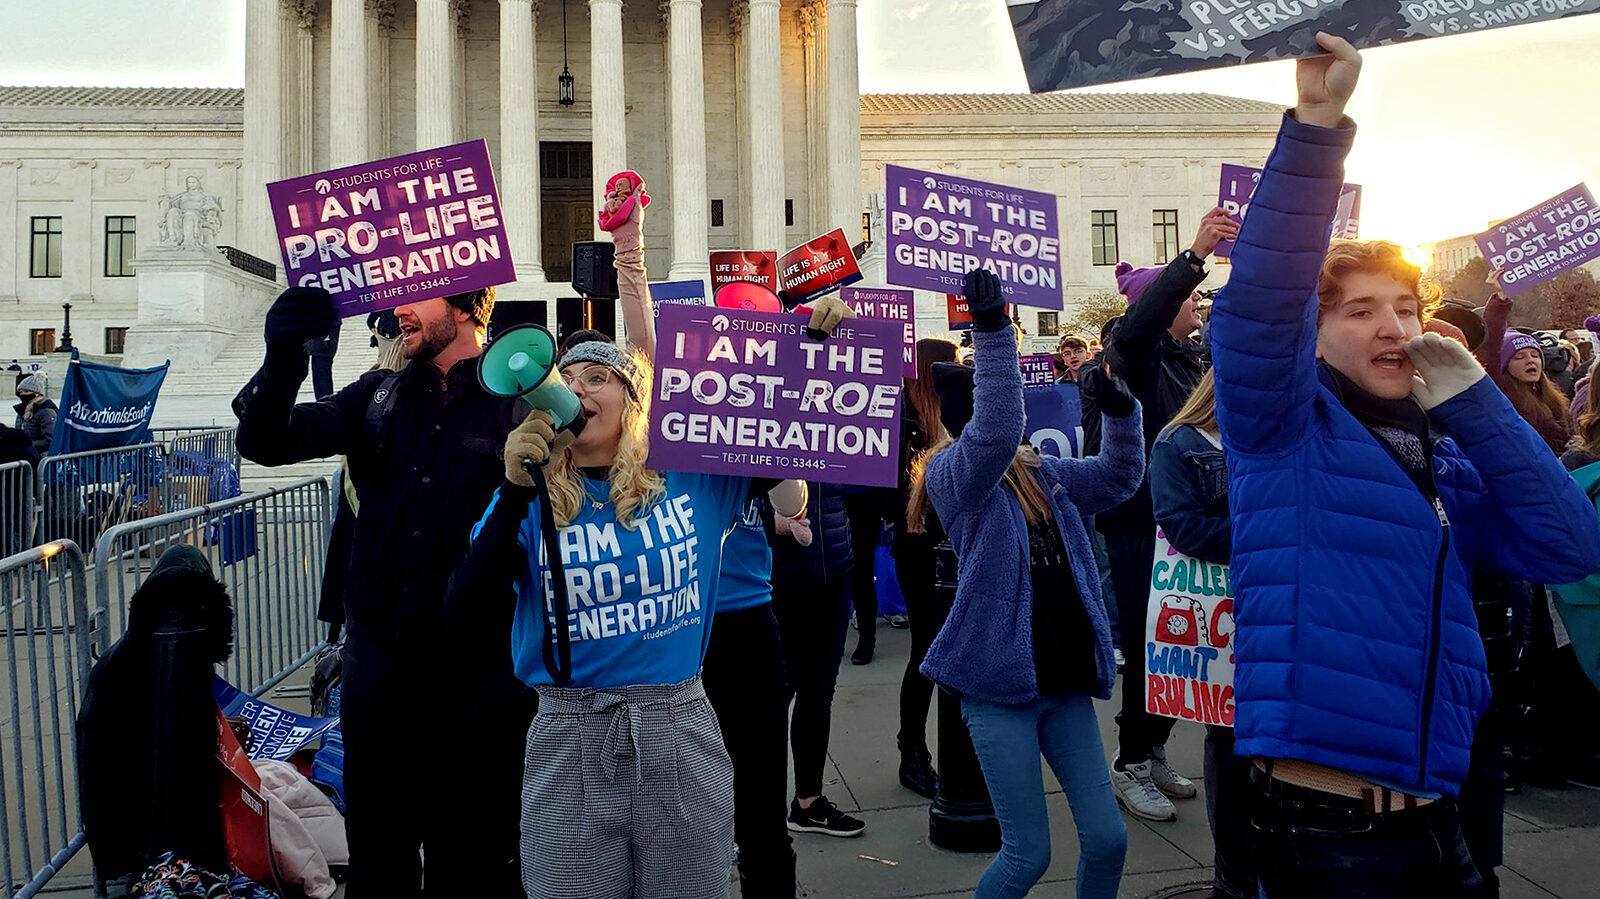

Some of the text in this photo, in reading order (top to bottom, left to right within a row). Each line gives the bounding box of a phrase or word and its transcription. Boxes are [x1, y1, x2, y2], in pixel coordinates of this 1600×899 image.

[1184, 0, 1334, 52] VS. FERG
[1430, 18, 1468, 34] VS.
[333, 157, 443, 189] STUDENTS FOR LIFE
[288, 167, 478, 229] I AM THE
[899, 186, 1047, 231] I AM THE
[937, 181, 1024, 204] STUDENTS FOR LIFE
[284, 194, 499, 270] PRO-LIFE
[891, 211, 1059, 262] POST-ROE
[1487, 196, 1588, 253] I AM THE
[1507, 211, 1539, 229] STUDENTS
[1490, 207, 1600, 270] POST-ROE
[715, 264, 749, 272] LIFE IS A
[783, 256, 820, 278] LIFE IS A
[785, 256, 846, 289] HUMAN RIGHT
[940, 275, 958, 287] TEXT
[359, 276, 451, 304] TEXT LIFE TO 53445
[731, 319, 795, 335] STUDENTS
[855, 302, 908, 319] AM THE
[829, 327, 855, 340] LIFE
[675, 332, 686, 359] I
[707, 336, 776, 367] AM
[800, 341, 884, 375] THE
[1023, 362, 1049, 371] THE
[660, 367, 900, 419] POST-ROE
[661, 412, 890, 457] GENERATION
[722, 452, 826, 470] TEXT LIFE TO 53445
[559, 522, 622, 564] AM
[630, 493, 695, 550] THE
[1147, 642, 1219, 681] WANT
[1147, 674, 1235, 726] RULING
